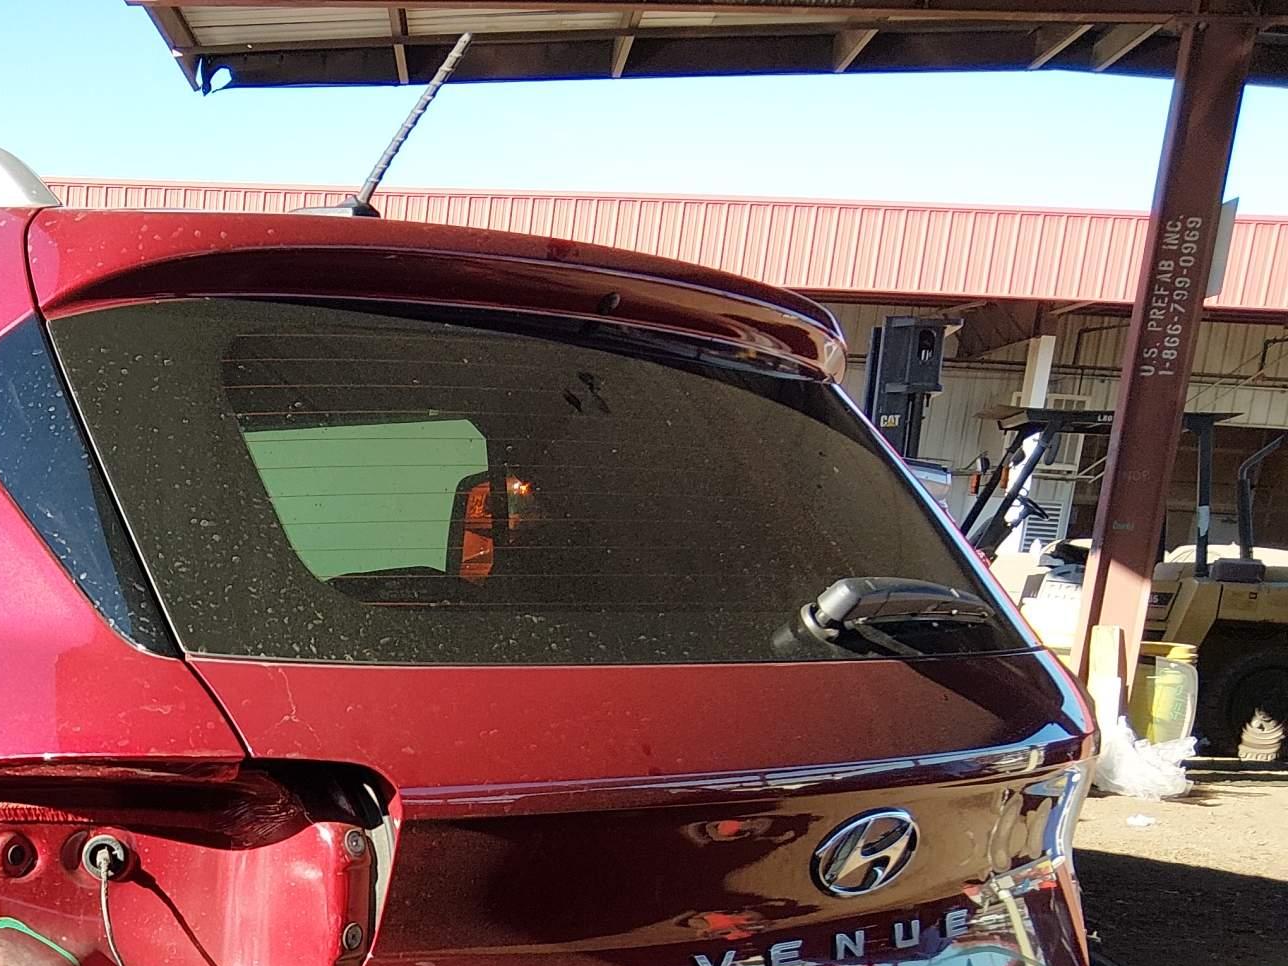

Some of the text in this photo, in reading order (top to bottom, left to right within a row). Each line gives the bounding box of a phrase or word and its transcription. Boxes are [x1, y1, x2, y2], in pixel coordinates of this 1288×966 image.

[1140, 215, 1185, 376] U.S. PREFAB INC.
[1158, 216, 1203, 375] 1-866-799-0969
[880, 414, 901, 427] CAT
